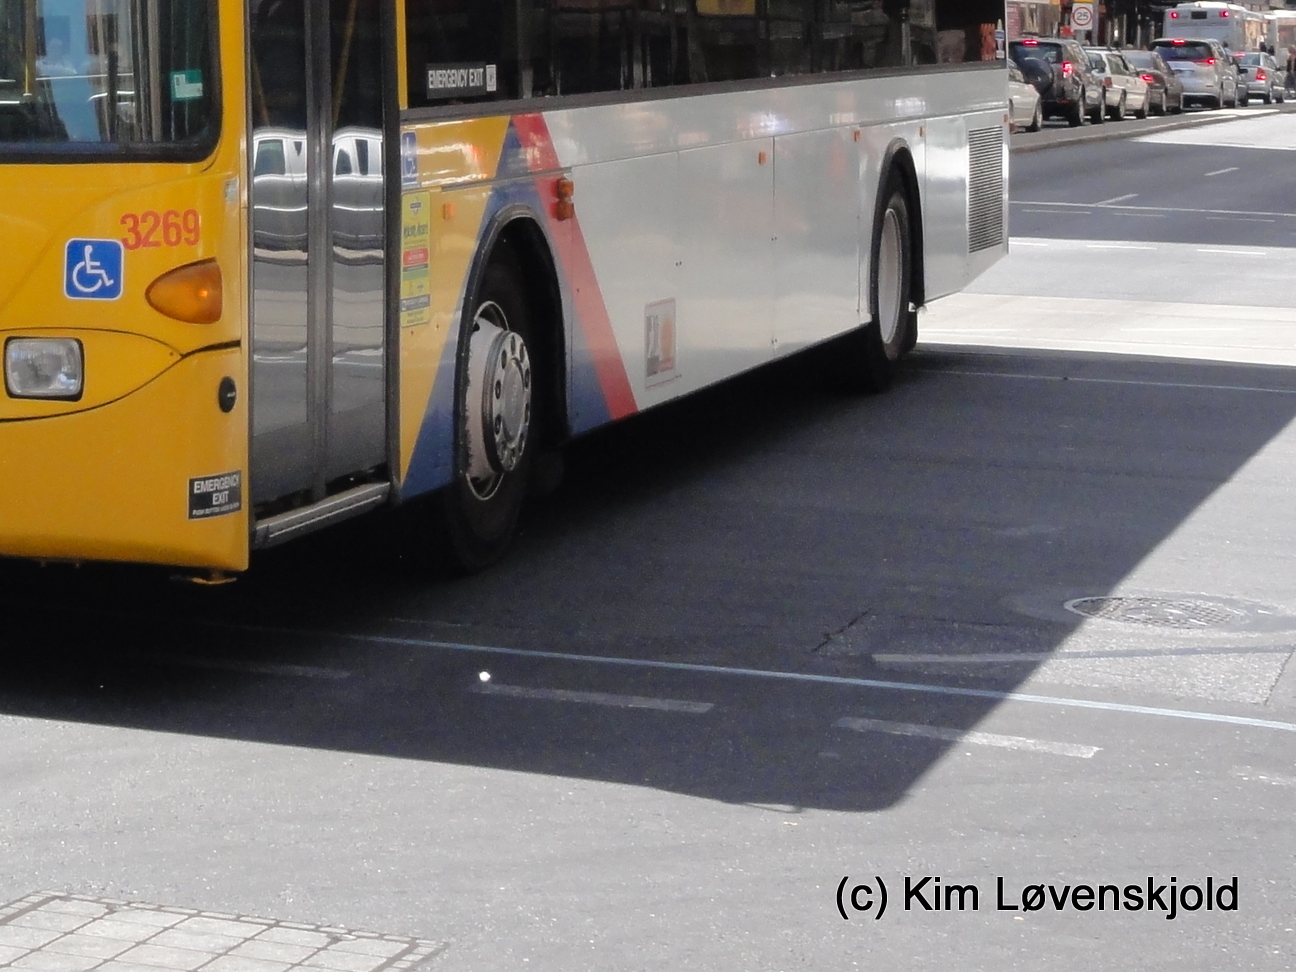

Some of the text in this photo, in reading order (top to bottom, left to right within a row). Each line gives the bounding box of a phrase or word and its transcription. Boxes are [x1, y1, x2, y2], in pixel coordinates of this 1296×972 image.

[1076, 11, 1089, 21] 25
[428, 68, 484, 89] EMERGENCY EXIT
[120, 208, 201, 250] 3269
[212, 490, 229, 505] EXIT
